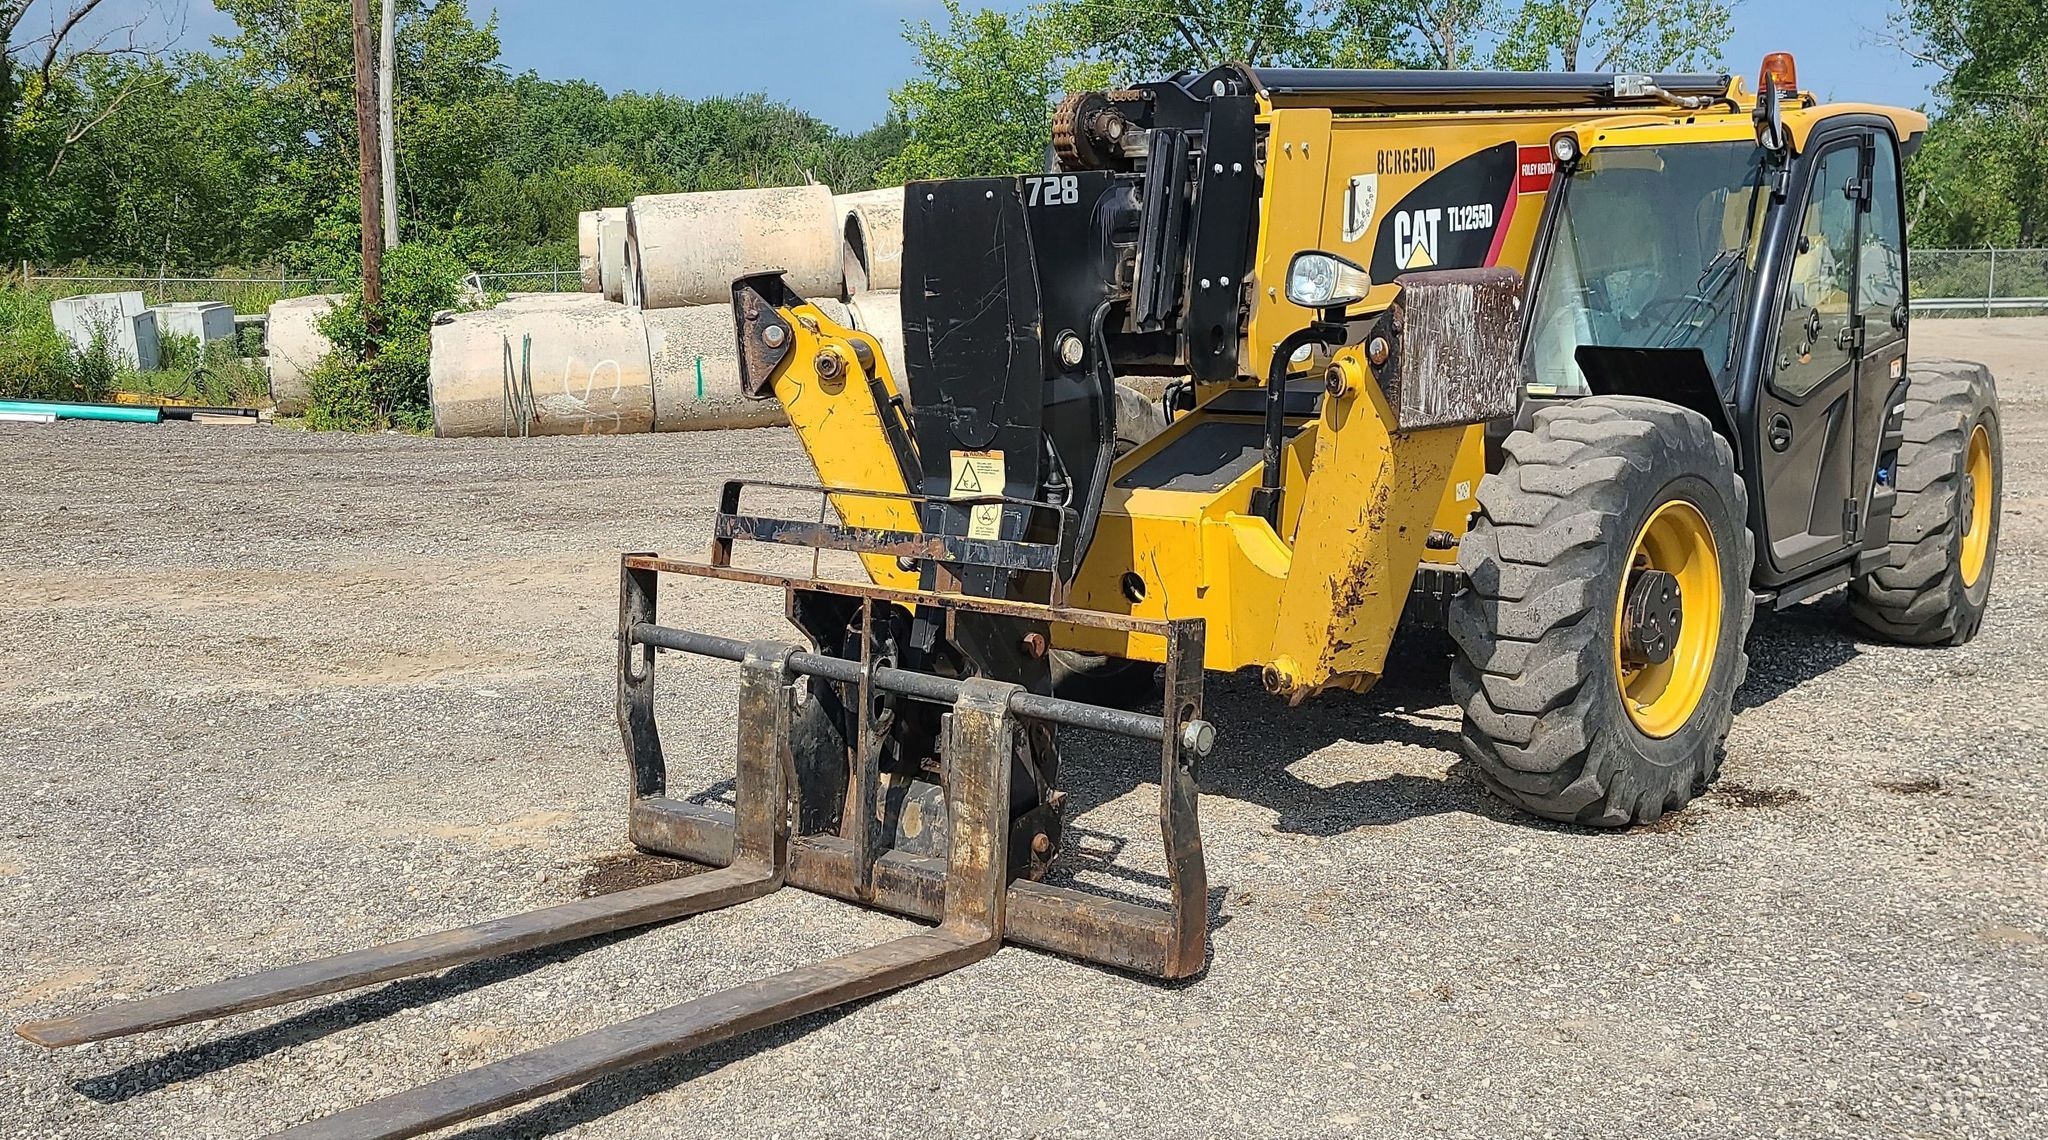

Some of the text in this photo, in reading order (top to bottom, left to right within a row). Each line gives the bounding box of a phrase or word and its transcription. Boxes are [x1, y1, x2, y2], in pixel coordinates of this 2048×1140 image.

[1377, 146, 1435, 175] 8CR6500
[1521, 162, 1537, 177] FOLEY
[1025, 175, 1079, 207] 728
[1394, 208, 1441, 270] CAT
[1447, 203, 1493, 232] TL1255D
